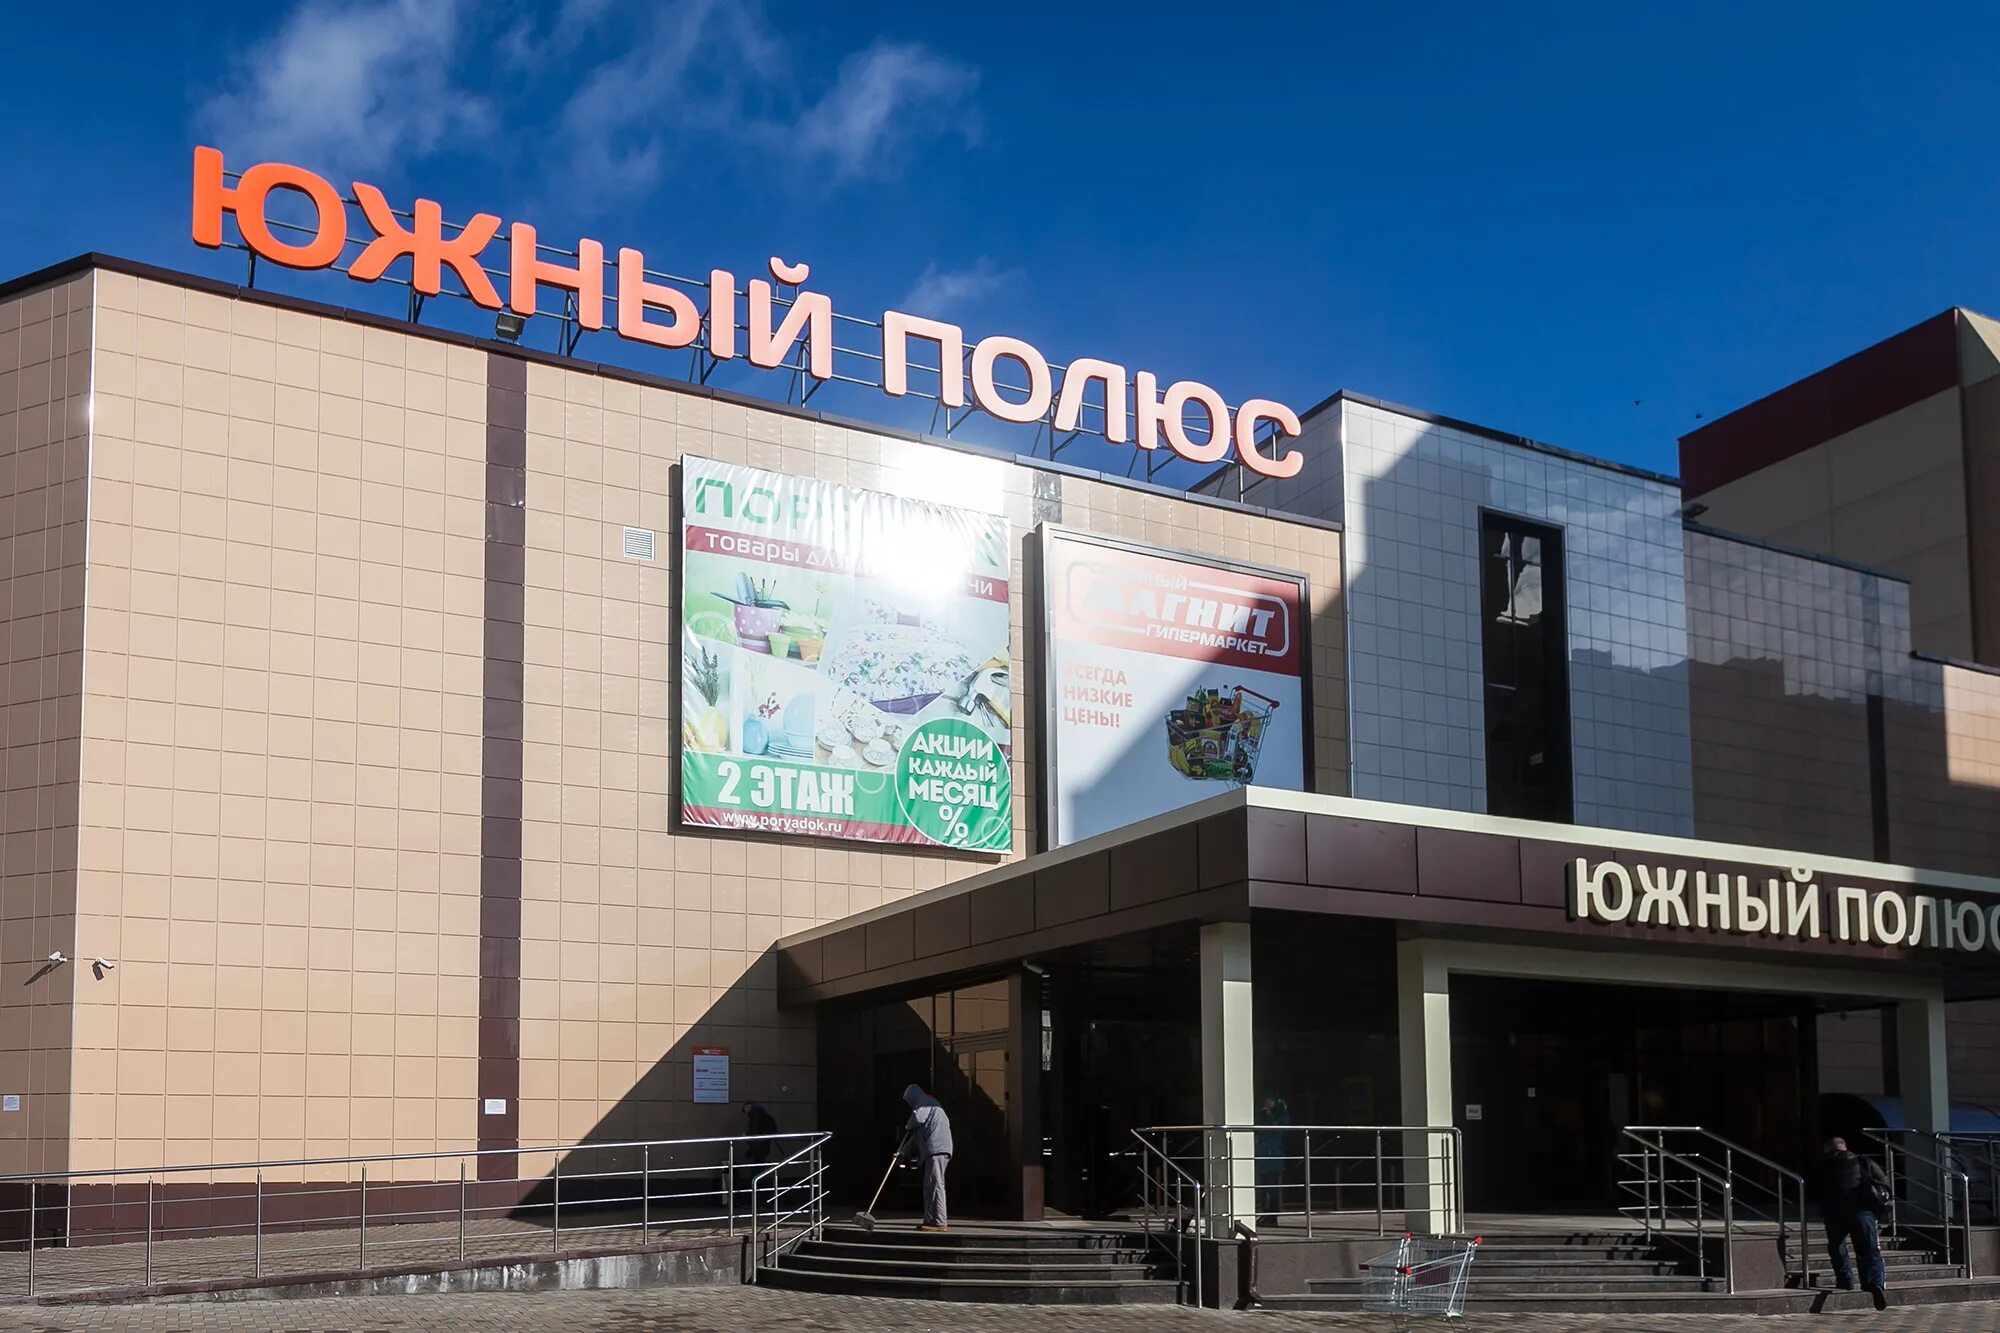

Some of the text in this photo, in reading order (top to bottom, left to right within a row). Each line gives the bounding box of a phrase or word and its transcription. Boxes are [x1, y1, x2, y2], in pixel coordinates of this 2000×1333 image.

[192, 145, 1304, 479] ЮЖНЫЙ ПОЛЮС
[1083, 579, 1275, 638] МАГНИТ
[1144, 624, 1267, 655] ГИПЕРМАРКЕТ
[1064, 663, 1127, 686] ВСЕГДА
[1064, 685, 1132, 707] НИЗКИЕ
[1064, 706, 1120, 728] ЦЕНЫ!
[911, 732, 993, 761] АКЦИИ
[909, 757, 997, 782] КАЖДЫЙ
[717, 762, 854, 816] 2 ЭТАЖ
[909, 780, 998, 810] МЕСЯЦ
[722, 811, 842, 833] www.poryadok.ru
[1576, 857, 1820, 938] ЮЖНЫЙ
